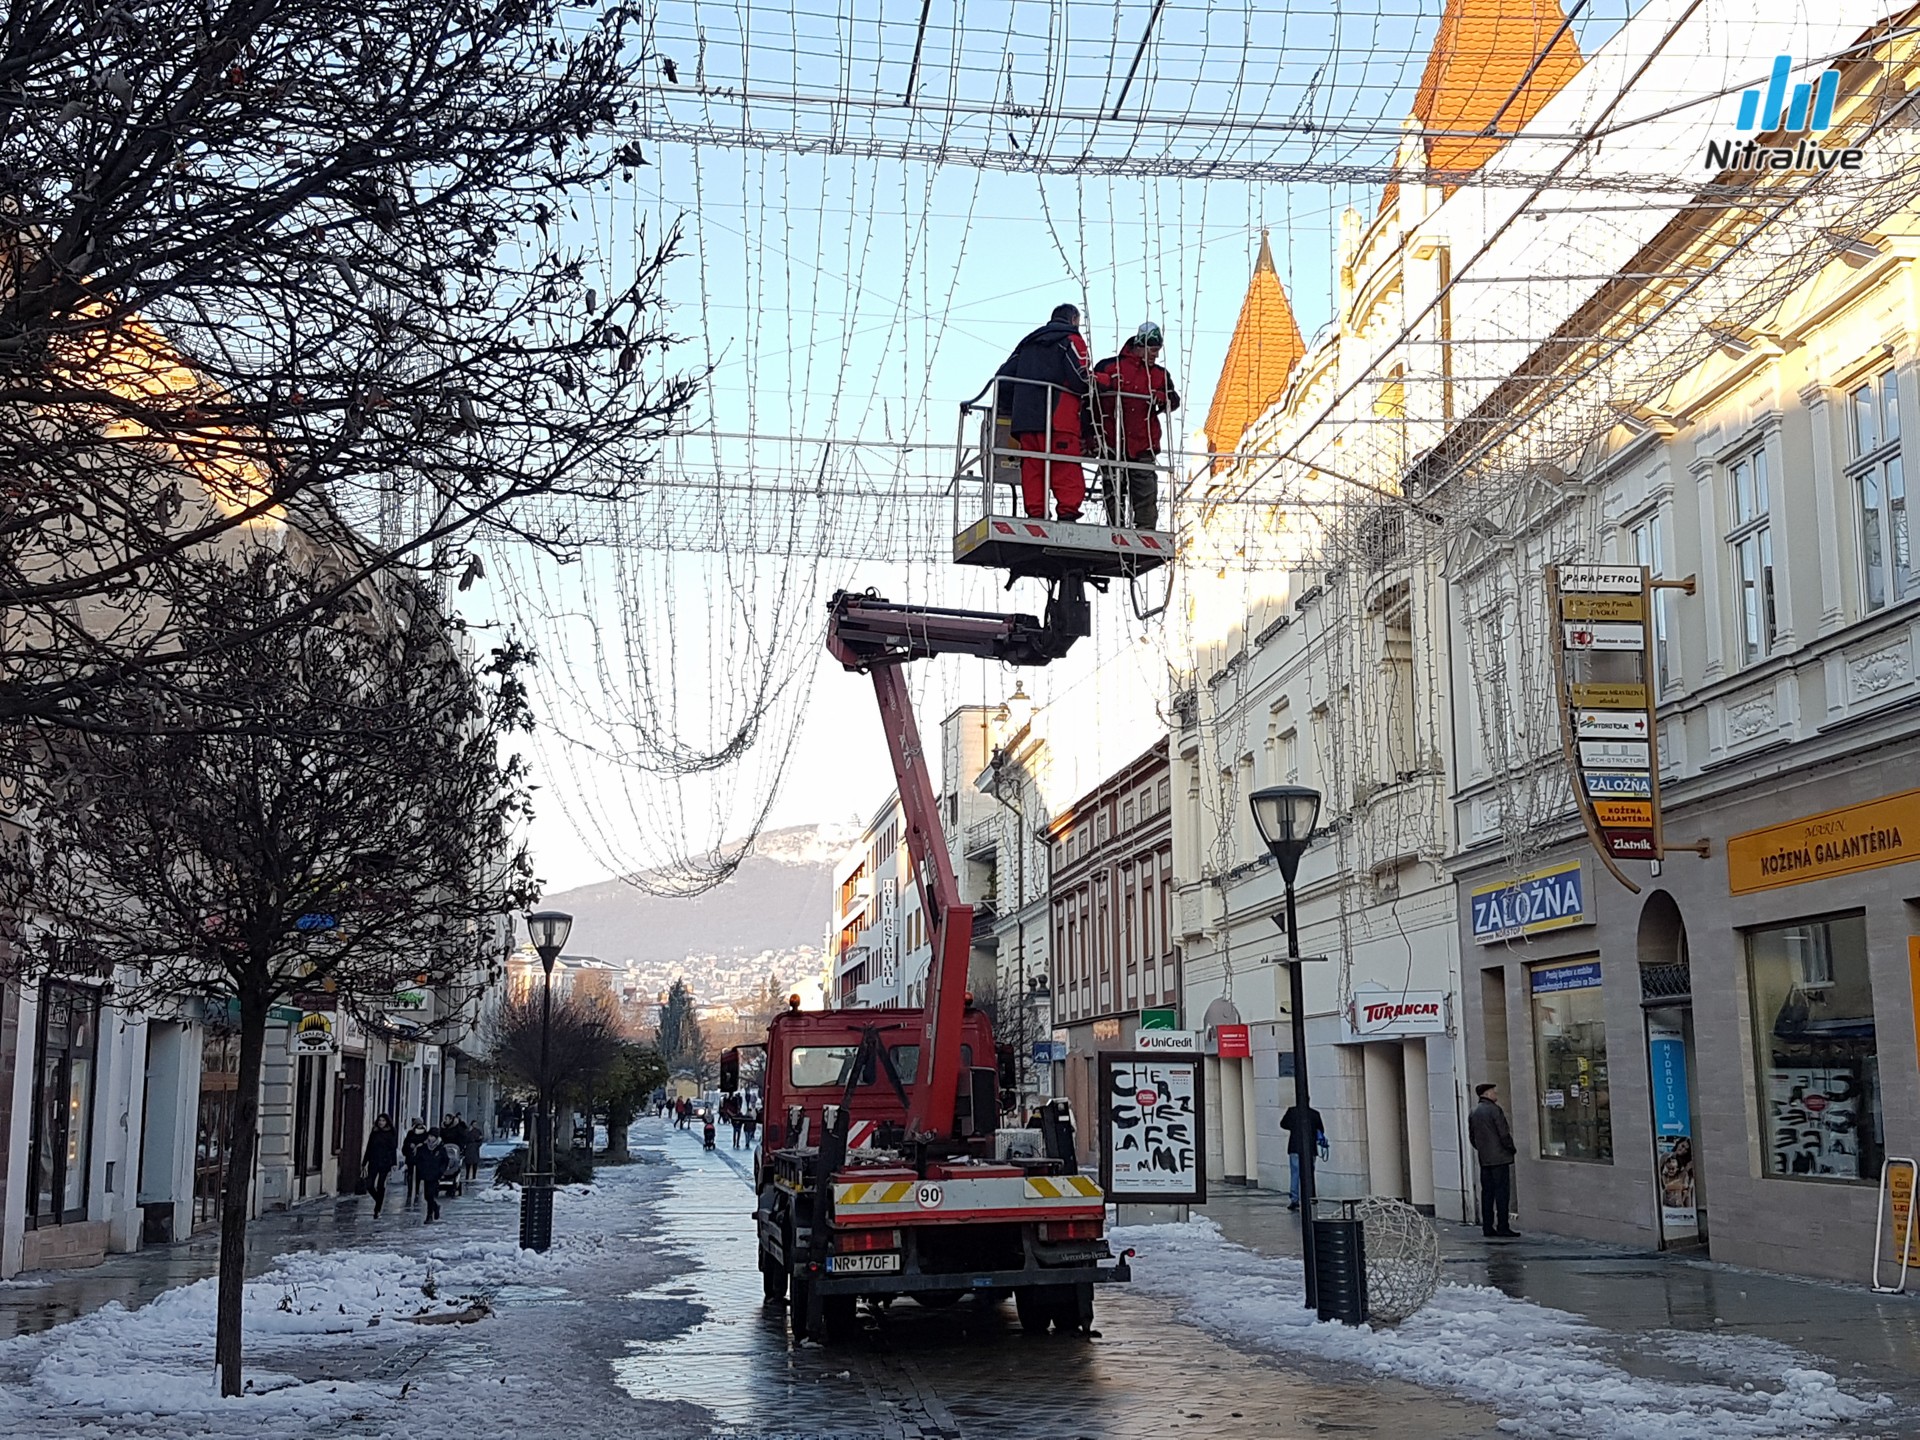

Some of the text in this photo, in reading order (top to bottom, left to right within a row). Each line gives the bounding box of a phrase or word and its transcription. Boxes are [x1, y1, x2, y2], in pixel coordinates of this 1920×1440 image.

[1589, 778, 1651, 791] ZÁLOŽŇA
[1608, 806, 1642, 815] KOŽENÁ
[1804, 820, 1847, 839] MARIN
[1761, 826, 1903, 876] KOŽENÁ GALANTÉRIA
[1475, 877, 1581, 933] ZÁLOŽŇA
[1363, 1002, 1439, 1023] TURANCAR
[1151, 1037, 1193, 1048] UniCredit
[1663, 1043, 1676, 1119] HYDROTOUR
[920, 1188, 939, 1202] 90
